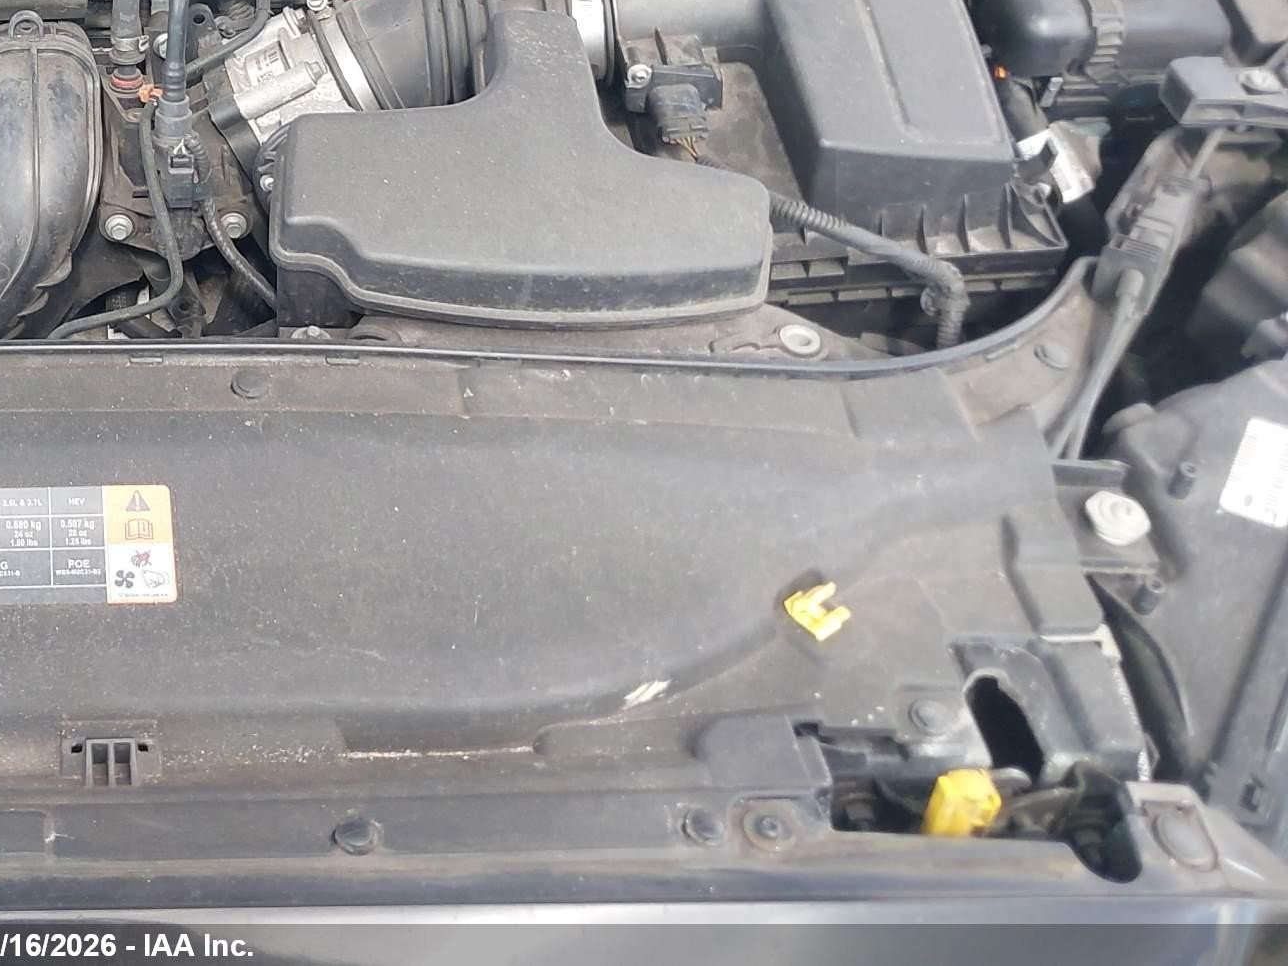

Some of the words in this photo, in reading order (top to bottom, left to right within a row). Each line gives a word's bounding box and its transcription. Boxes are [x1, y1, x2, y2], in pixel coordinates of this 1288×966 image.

[68, 497, 86, 506] HEV
[30, 520, 41, 531] kg
[83, 518, 95, 530] kg
[26, 538, 38, 547] lbs
[68, 559, 91, 568] POE
